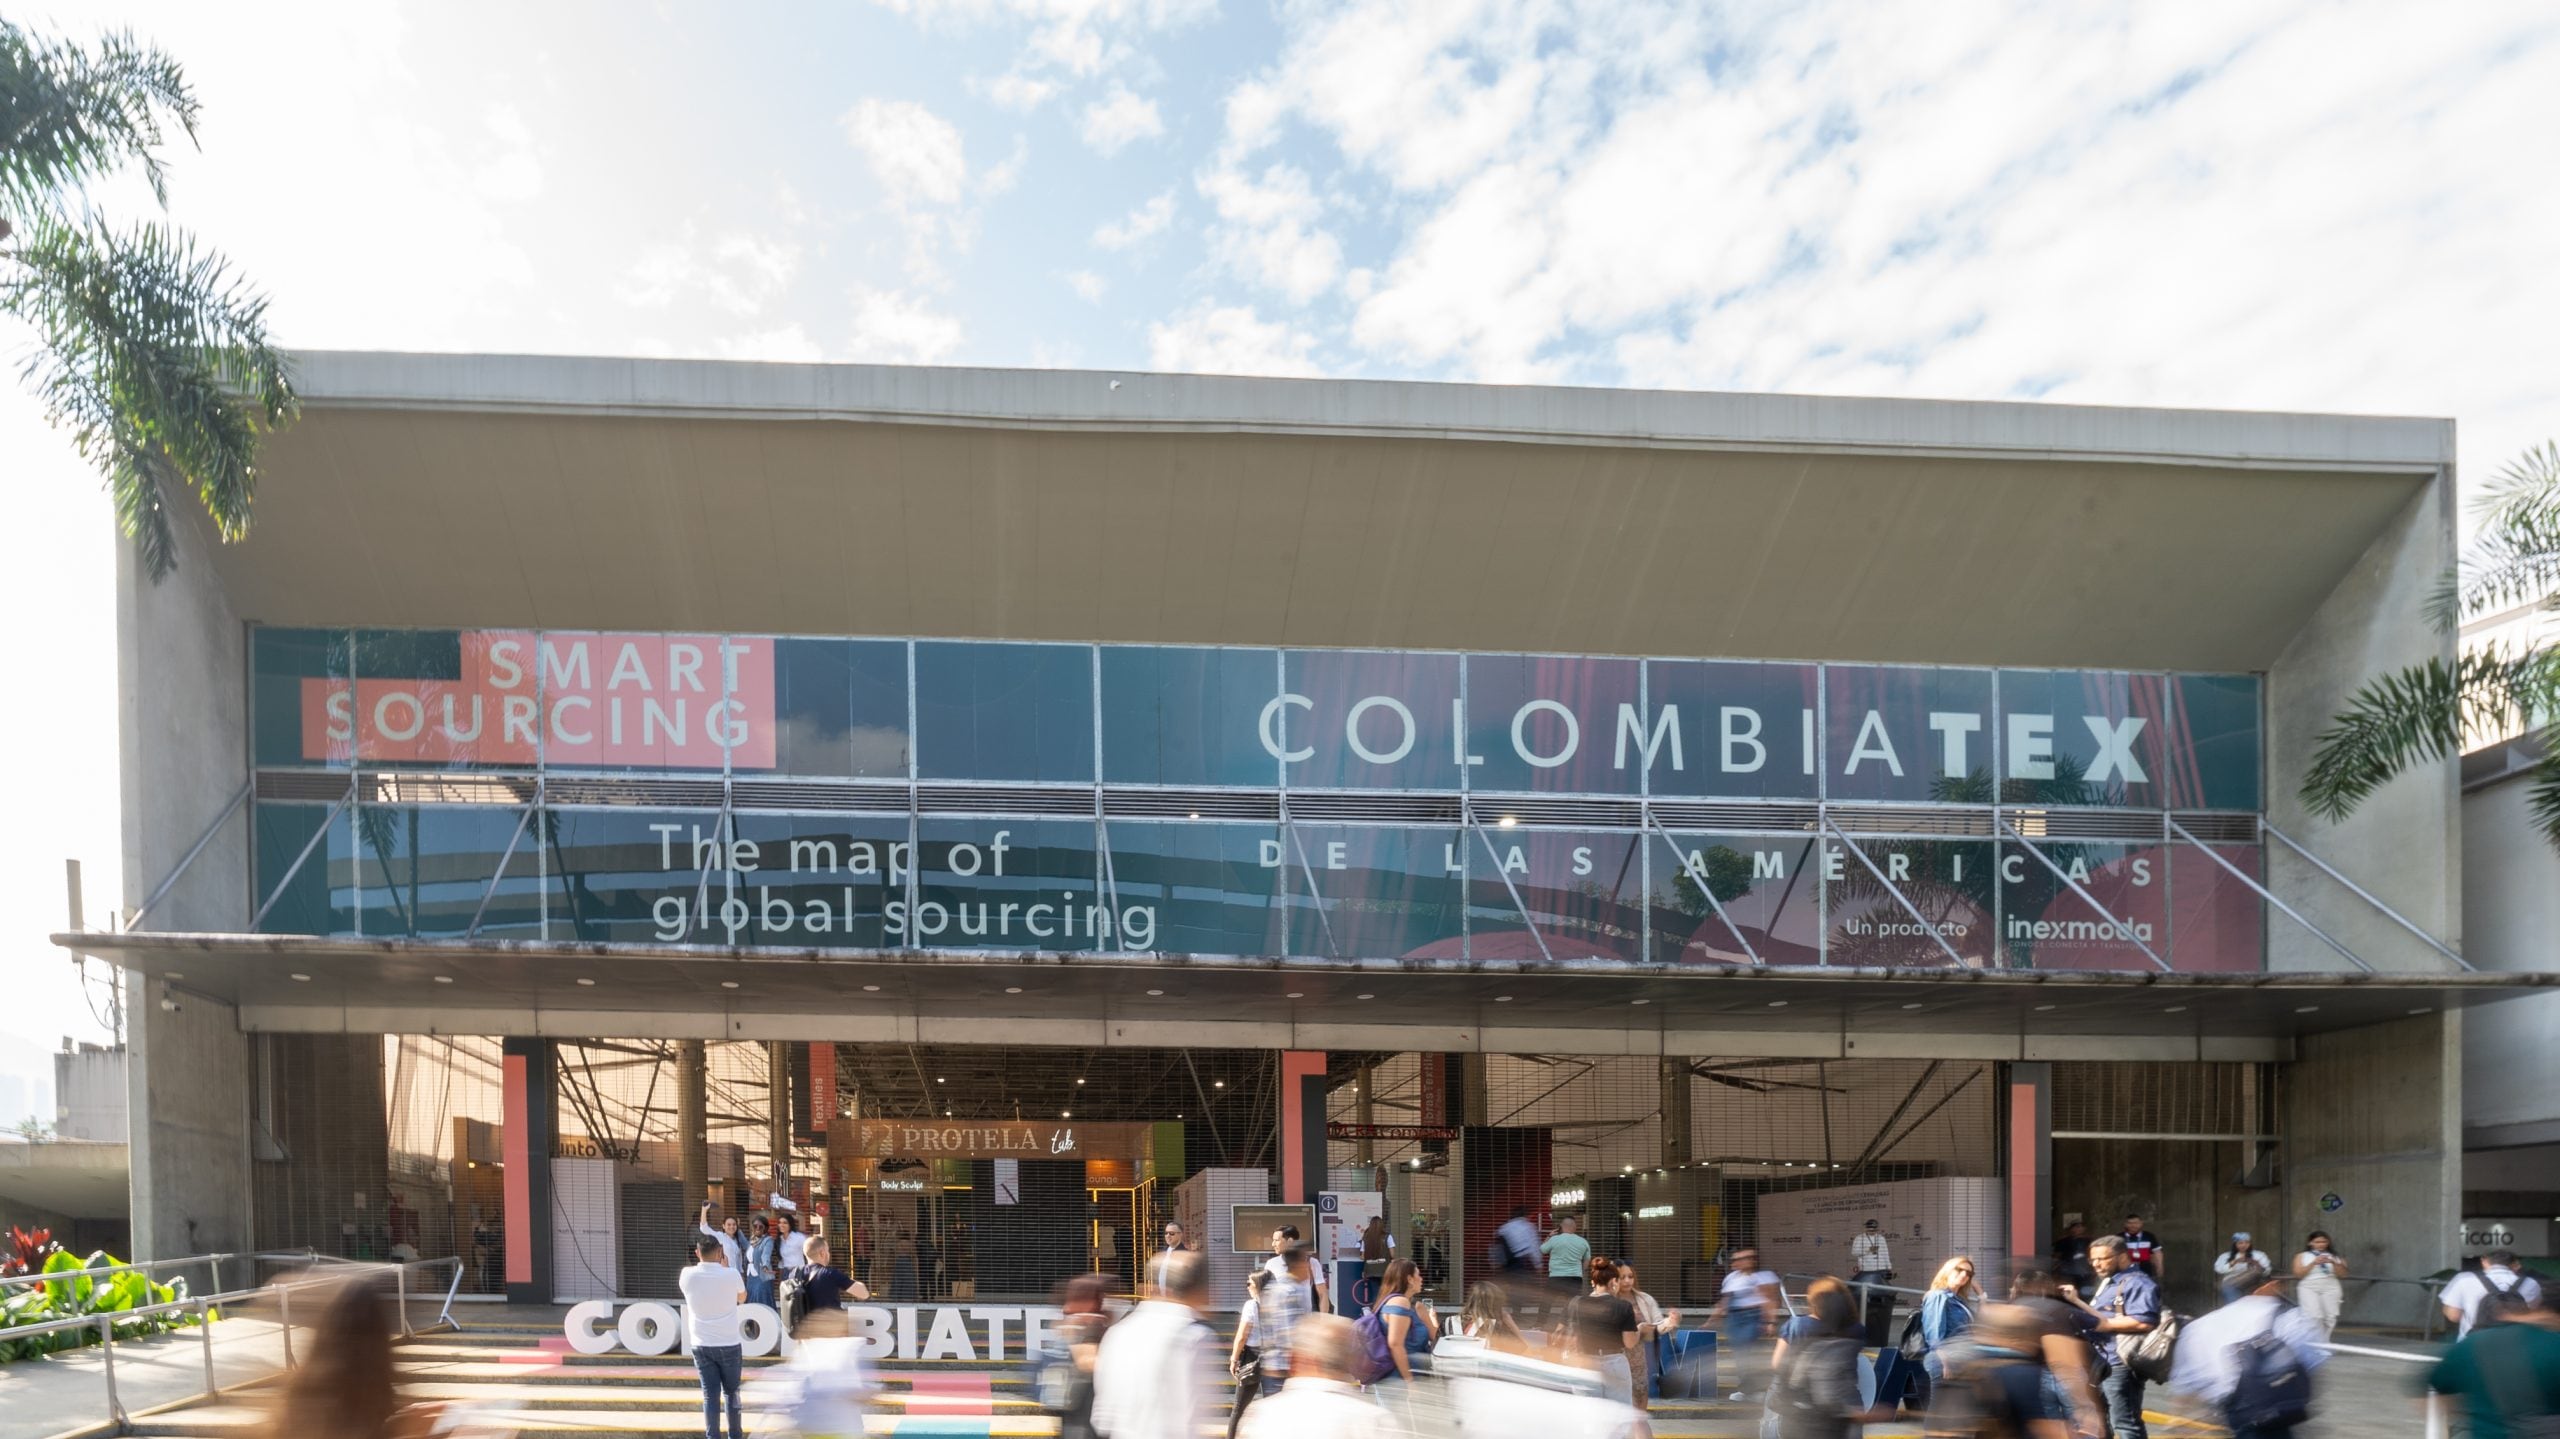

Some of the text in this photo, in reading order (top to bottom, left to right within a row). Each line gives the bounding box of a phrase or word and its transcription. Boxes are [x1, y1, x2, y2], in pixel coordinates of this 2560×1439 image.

[488, 640, 751, 693] SMART
[326, 690, 749, 748] SOURCING
[1258, 692, 2151, 784] COLOMBIATEX
[648, 823, 1011, 887] The map of
[1259, 839, 2153, 887] DE LAS AMÉRICAS
[651, 885, 1157, 952] global sourcing
[1846, 918, 1872, 936] Un
[2007, 913, 2153, 942] inexmoda
[813, 1077, 824, 1127] Textiles
[902, 1127, 1040, 1151] PROTELA
[880, 1180, 924, 1191] Body Sculpt
